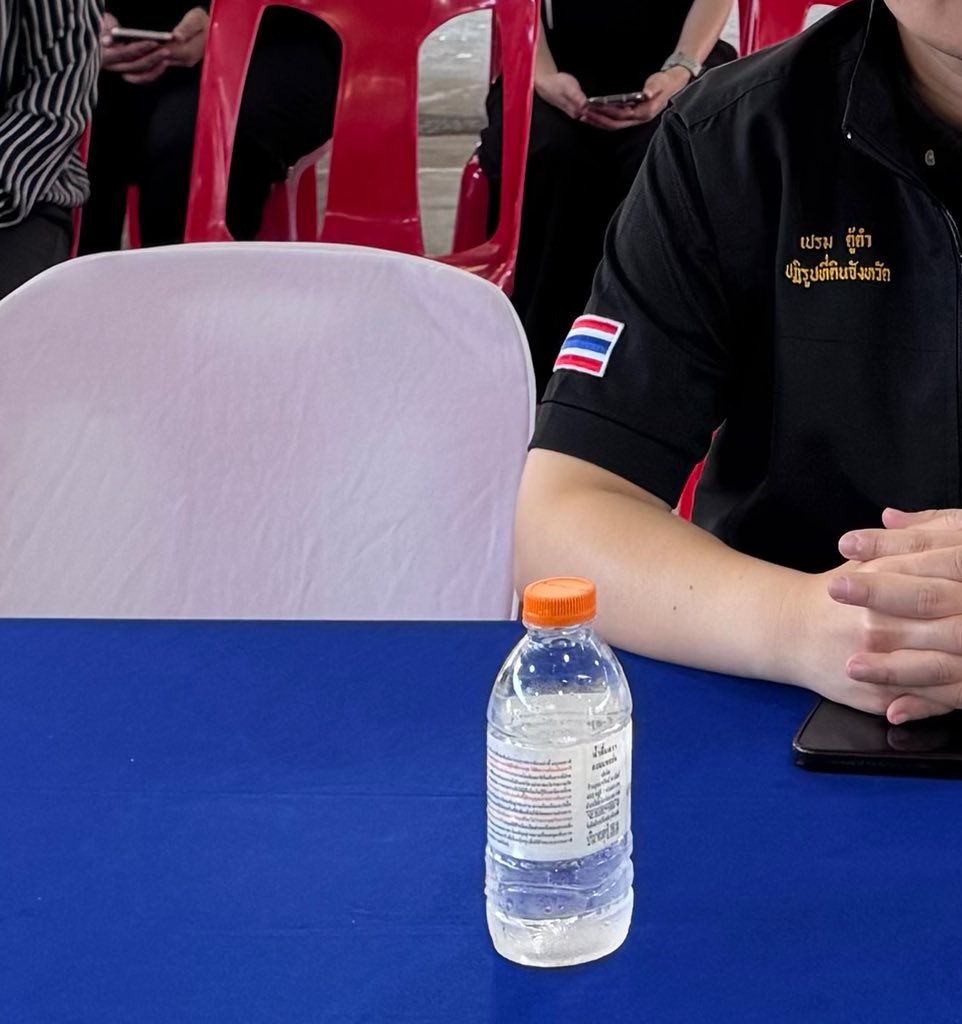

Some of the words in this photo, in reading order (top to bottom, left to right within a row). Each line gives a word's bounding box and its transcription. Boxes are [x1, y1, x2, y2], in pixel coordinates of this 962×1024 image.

[800, 234, 833, 249] เปรม
[785, 254, 891, 288] ปฏิรูปที่ดินจังหวัด
